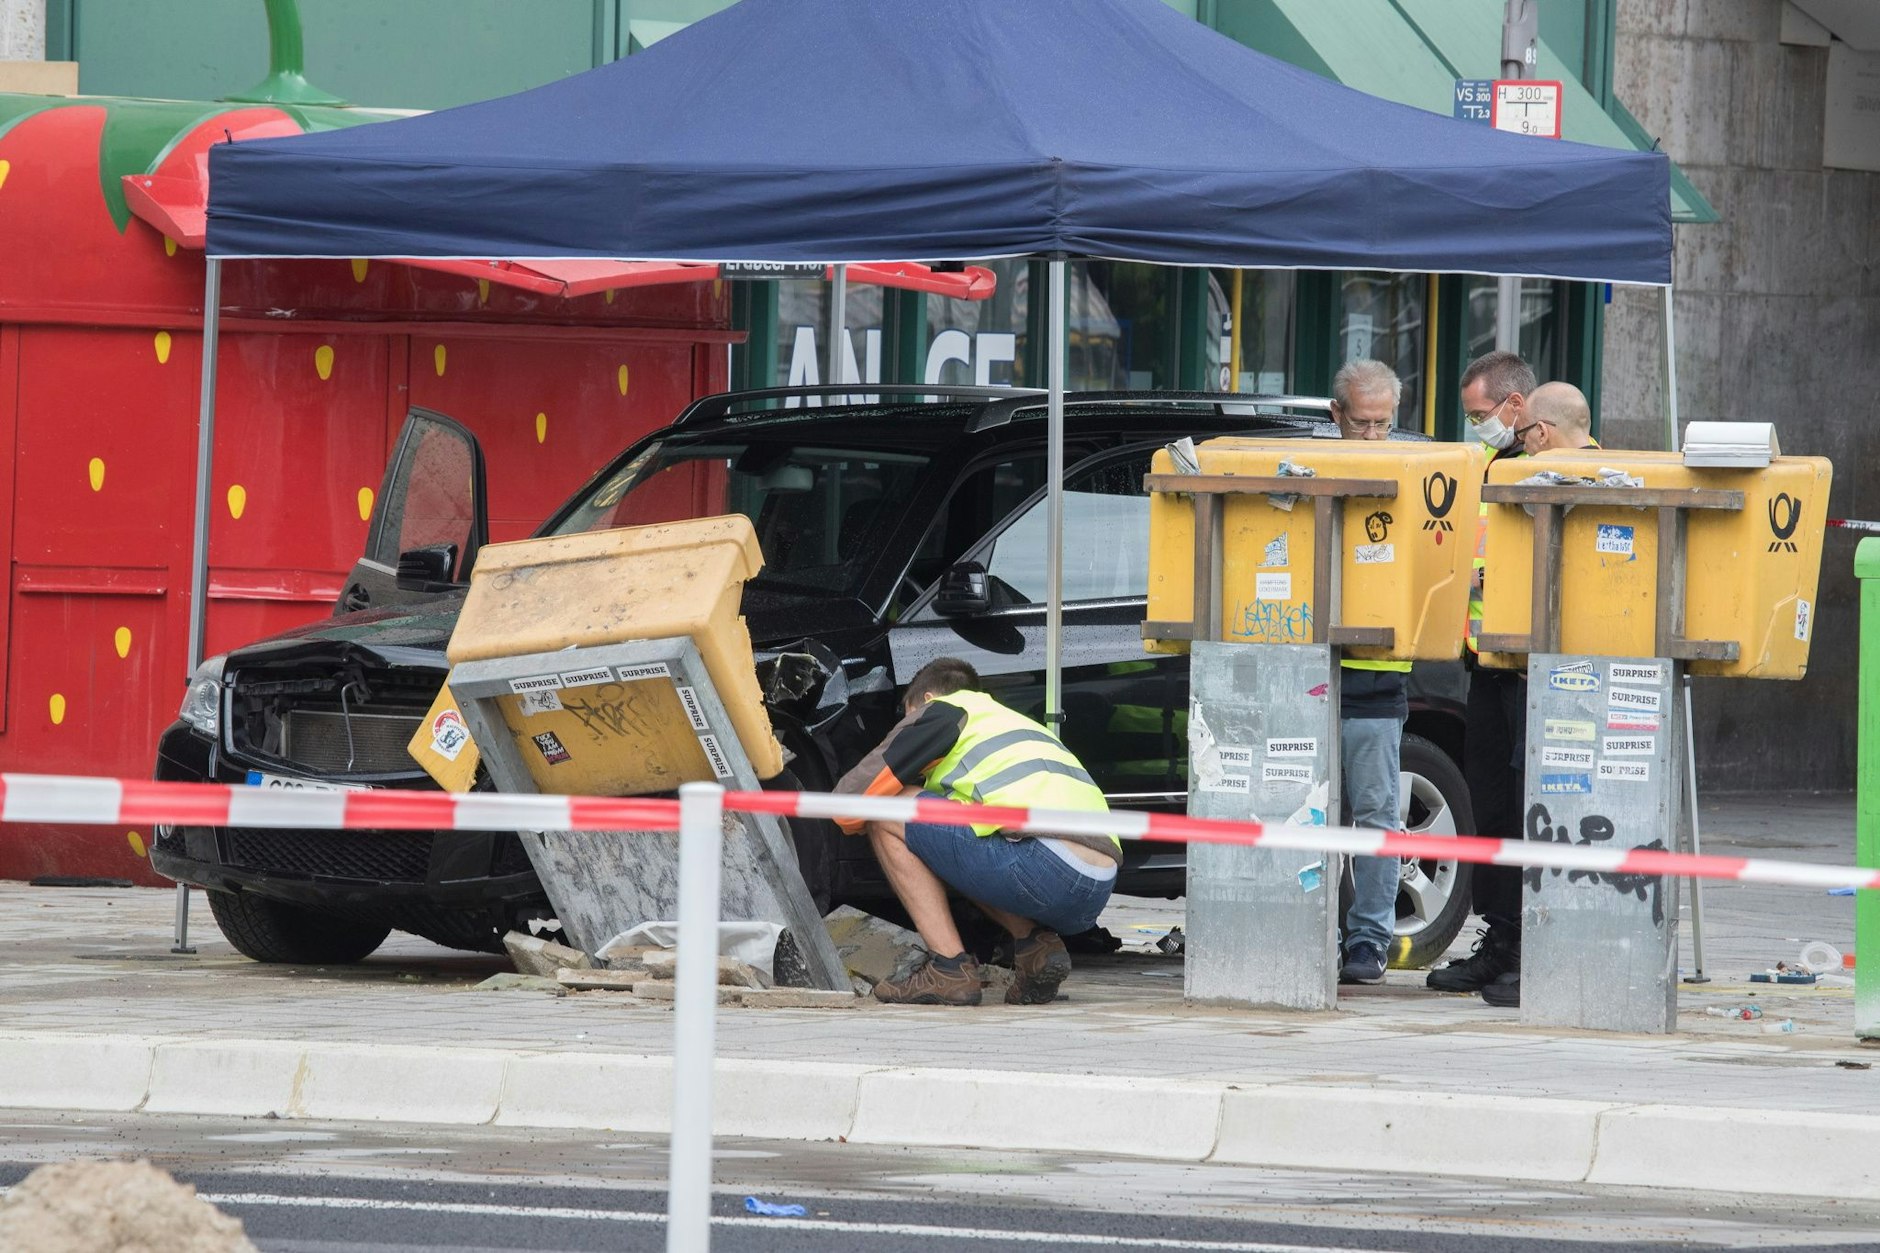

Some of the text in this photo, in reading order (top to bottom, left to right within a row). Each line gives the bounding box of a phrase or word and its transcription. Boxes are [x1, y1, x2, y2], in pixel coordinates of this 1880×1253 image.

[1456, 88, 1473, 102] VS
[1476, 93, 1491, 102] 300
[1498, 87, 1542, 100] H 300
[565, 671, 610, 684] SURPRISE
[621, 666, 667, 678] SURPRISE
[513, 678, 558, 690] SURPRISE
[1553, 677, 1596, 686] IKETA
[1611, 692, 1658, 705] SURPRISE
[682, 689, 704, 728] SURPRISE
[1270, 742, 1314, 752] SURPRISE
[1606, 741, 1652, 750] SURPRISE
[704, 737, 728, 775] SURPRISE
[1265, 768, 1310, 778] SURPRISE
[1600, 765, 1646, 775] SUPRISE
